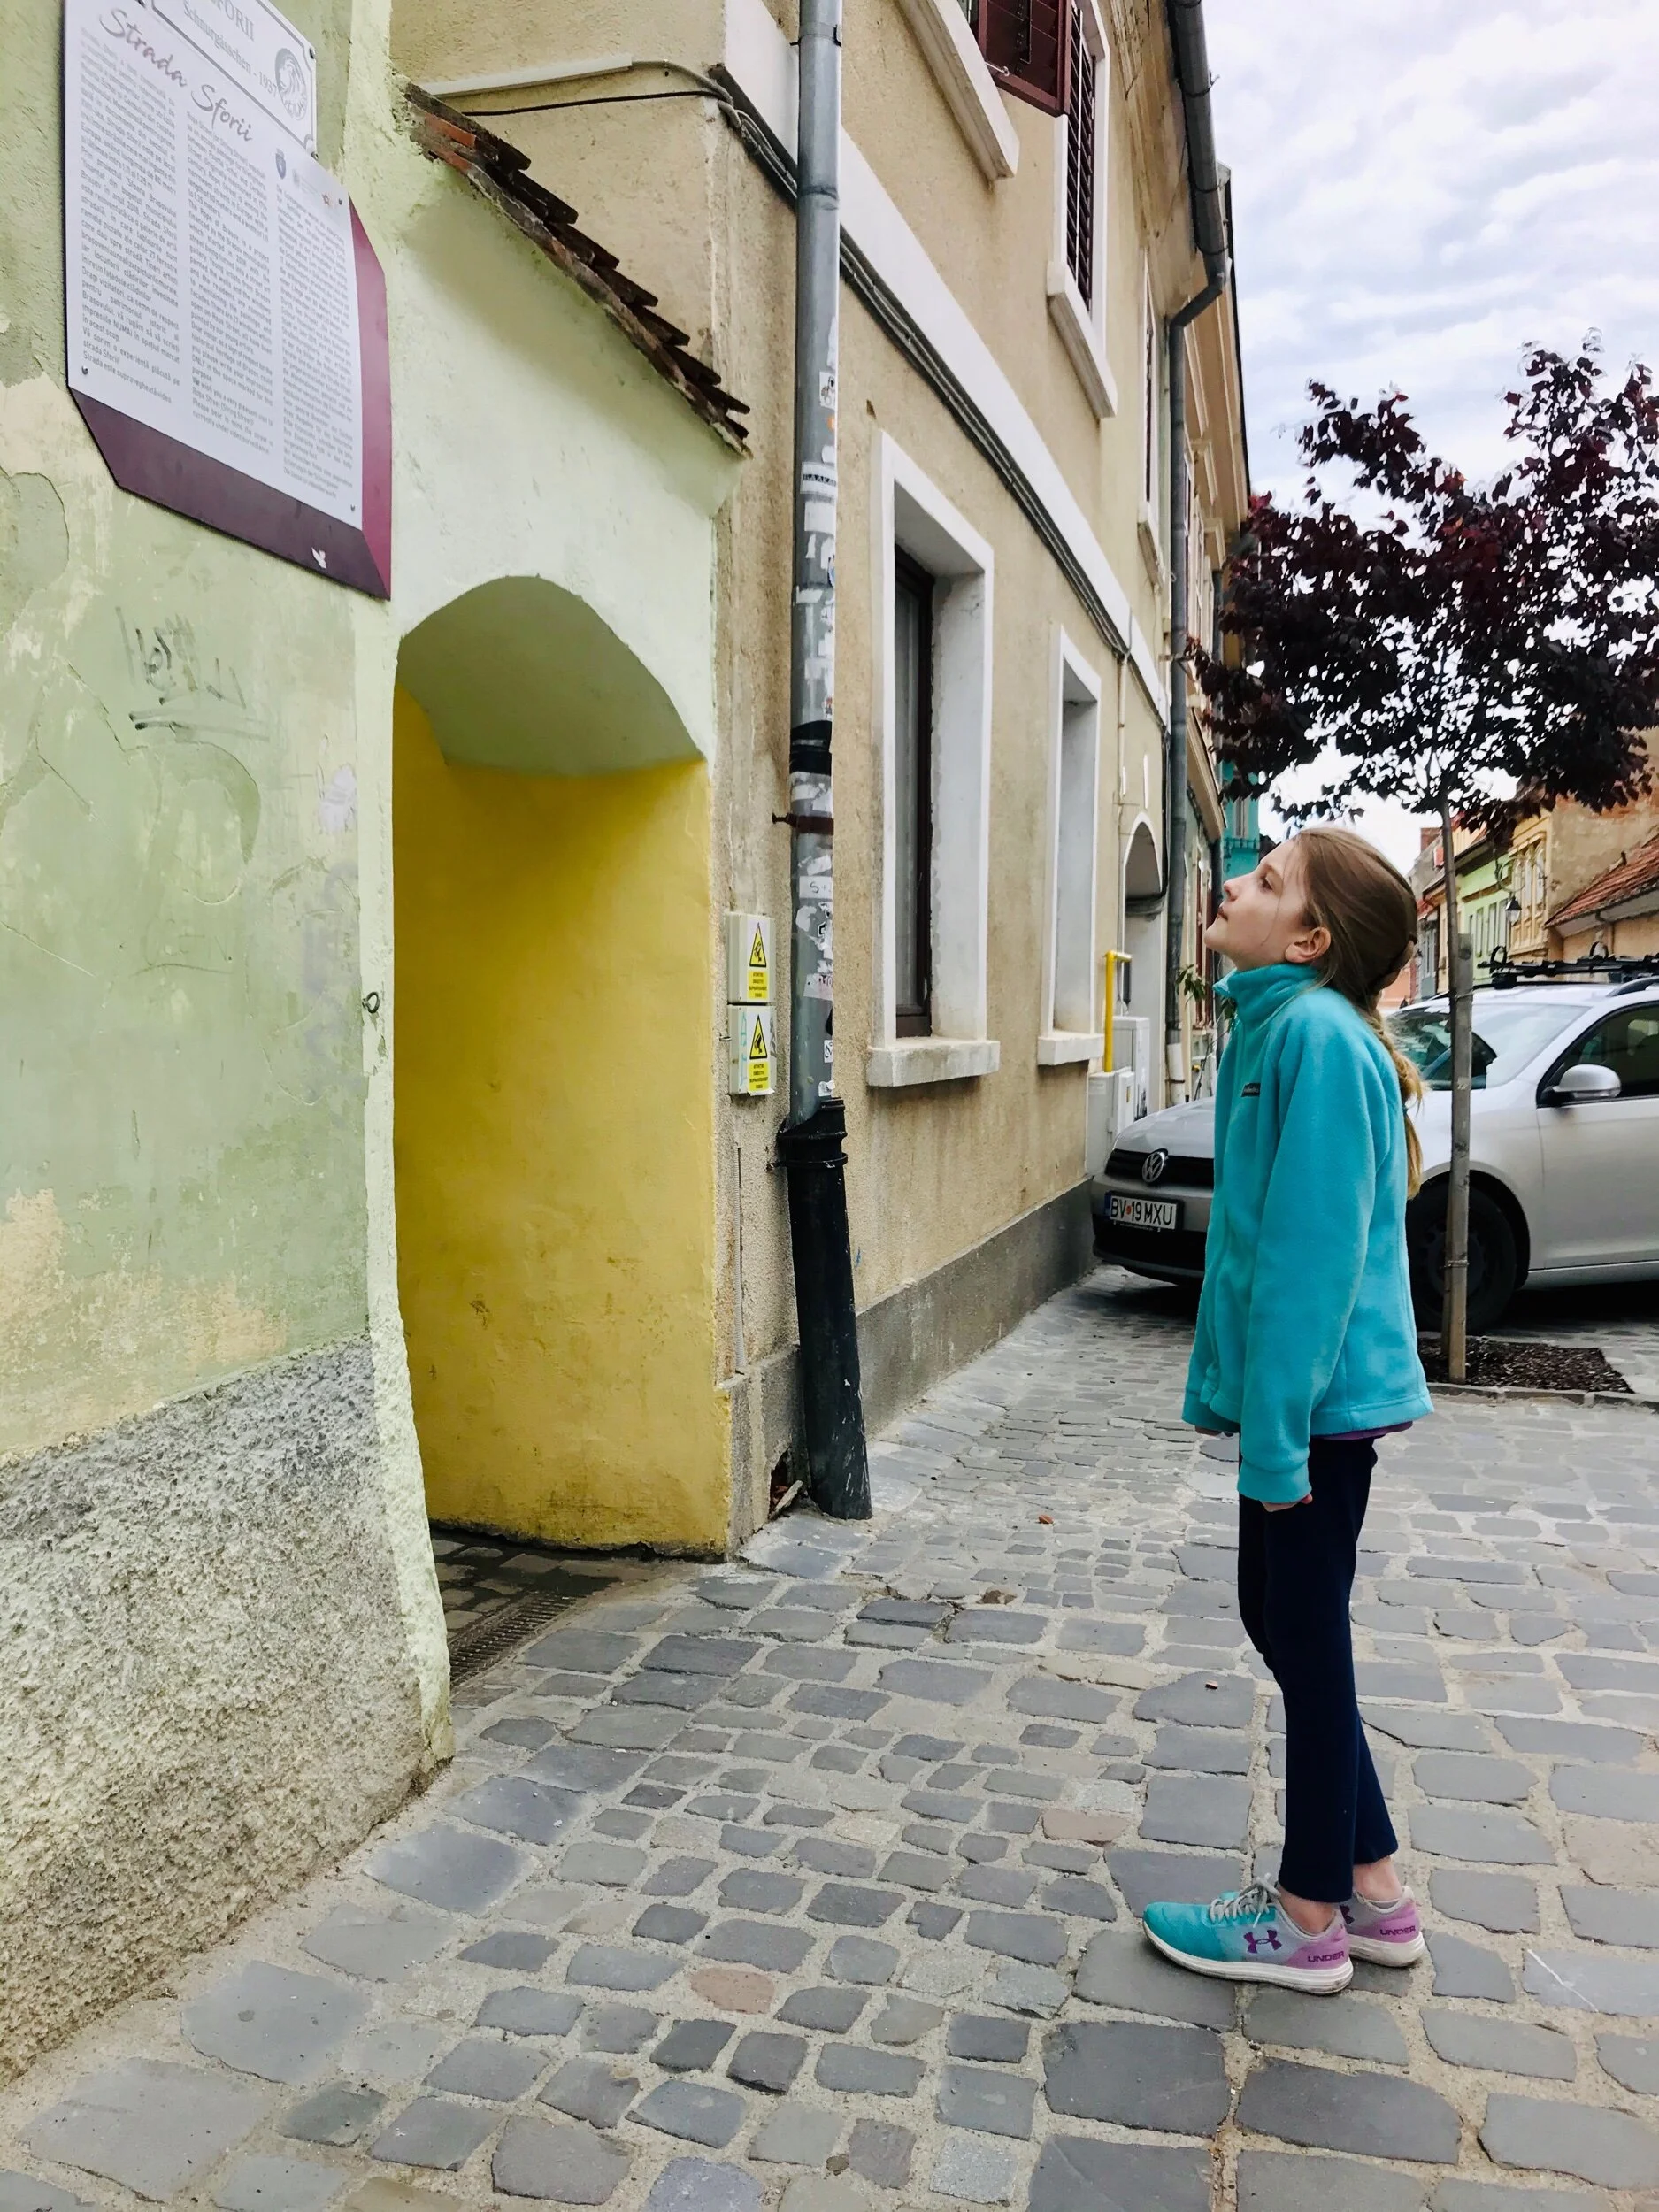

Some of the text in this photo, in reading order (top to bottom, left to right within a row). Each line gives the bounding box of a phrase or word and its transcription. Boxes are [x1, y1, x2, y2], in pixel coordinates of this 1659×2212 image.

[211, 0, 254, 42] ORII
[99, 8, 187, 88] Strada
[191, 84, 253, 142] Sforii
[1110, 1198, 1126, 1219] BV
[1132, 1201, 1142, 1222] 19
[1144, 1202, 1173, 1226] MXU
[1379, 1924, 1417, 1938] UNDER
[1307, 1950, 1345, 1964] UNDER
